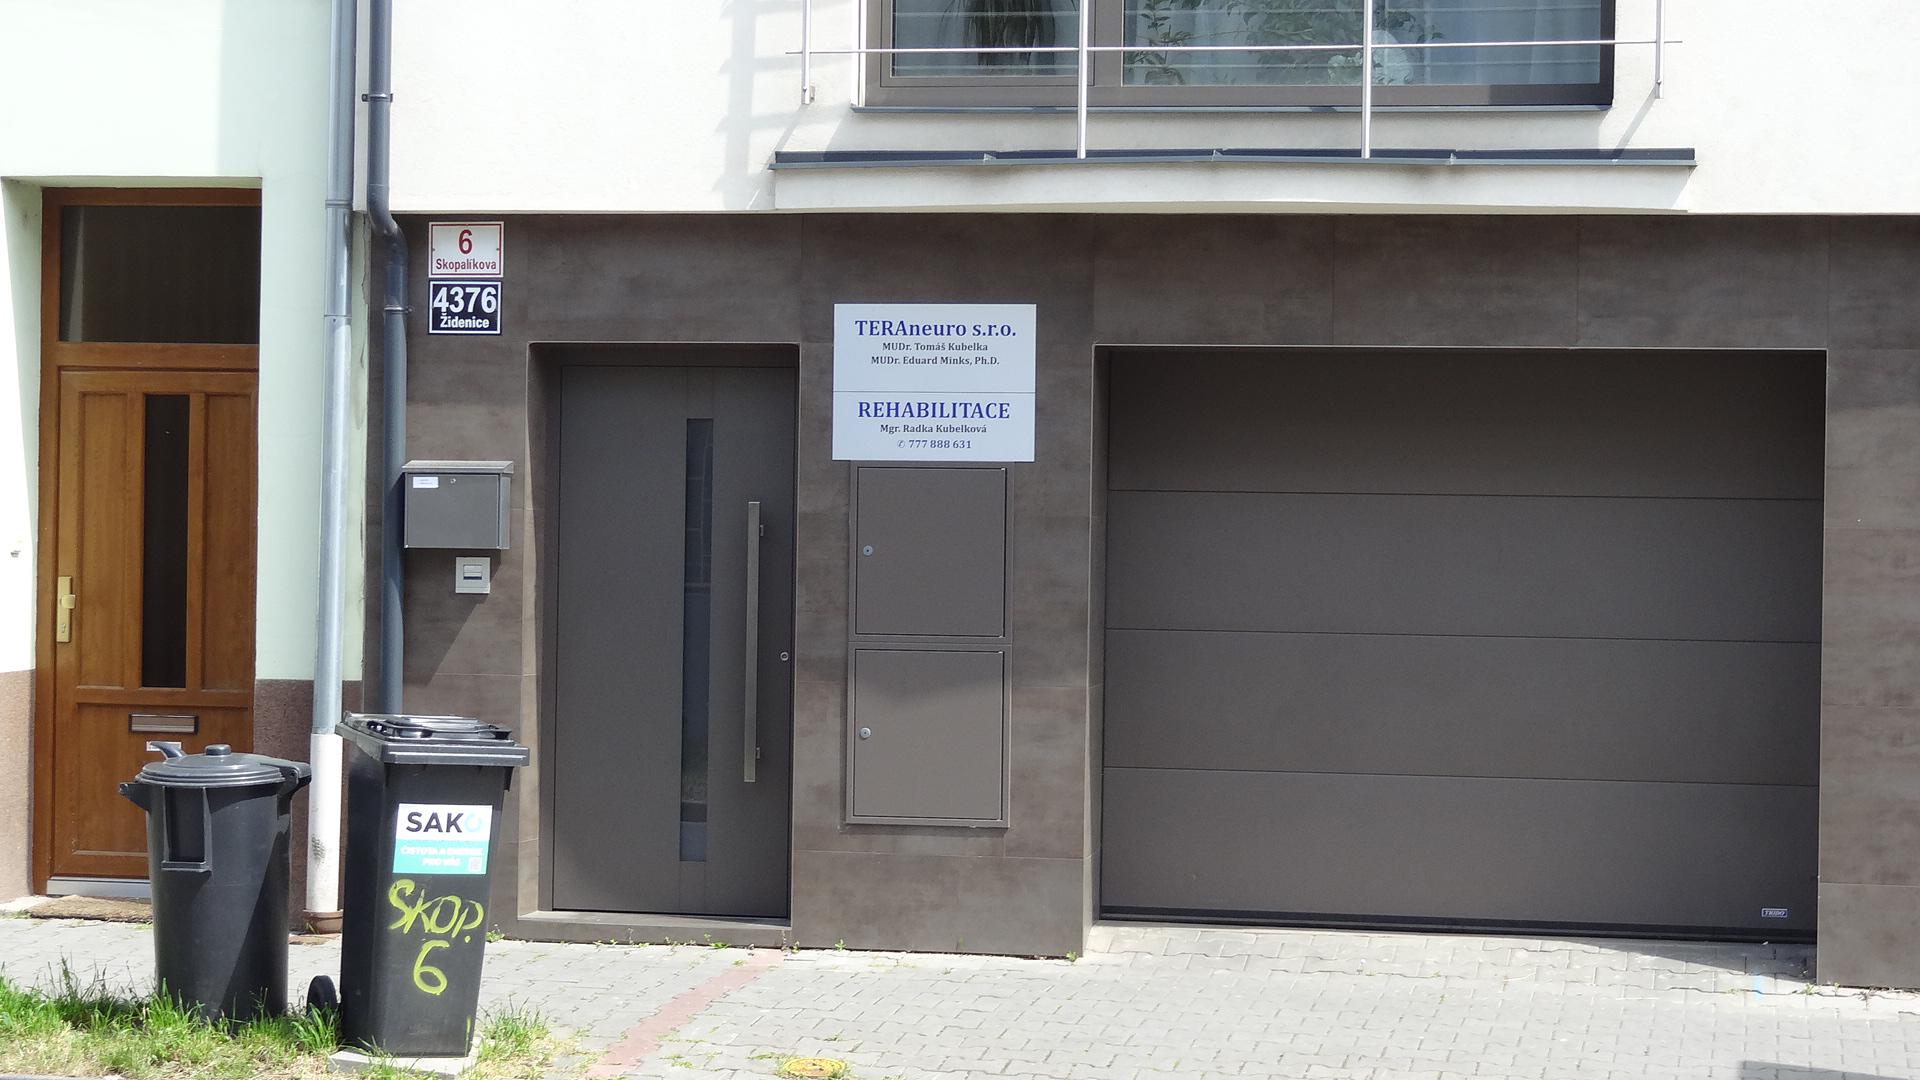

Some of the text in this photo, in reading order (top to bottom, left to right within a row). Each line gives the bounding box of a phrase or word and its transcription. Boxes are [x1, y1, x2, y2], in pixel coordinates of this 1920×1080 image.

[458, 229, 473, 254] 6
[435, 258, 497, 272] Skopalíkova
[433, 286, 497, 313] 4376
[440, 313, 490, 328] Židenice
[854, 320, 1017, 337] TERAneuro s.r.o.
[882, 342, 988, 351] MUDr. Tomáš Kubelka
[871, 356, 1000, 366] MUDr. Eduard Minks, Ph.D.
[858, 401, 1011, 419] REHABILITACE
[880, 424, 987, 434] Mgr. Radka Kubelková
[908, 440, 972, 449] 777 888 631
[405, 811, 482, 833] SAKO
[413, 939, 450, 995] 6
